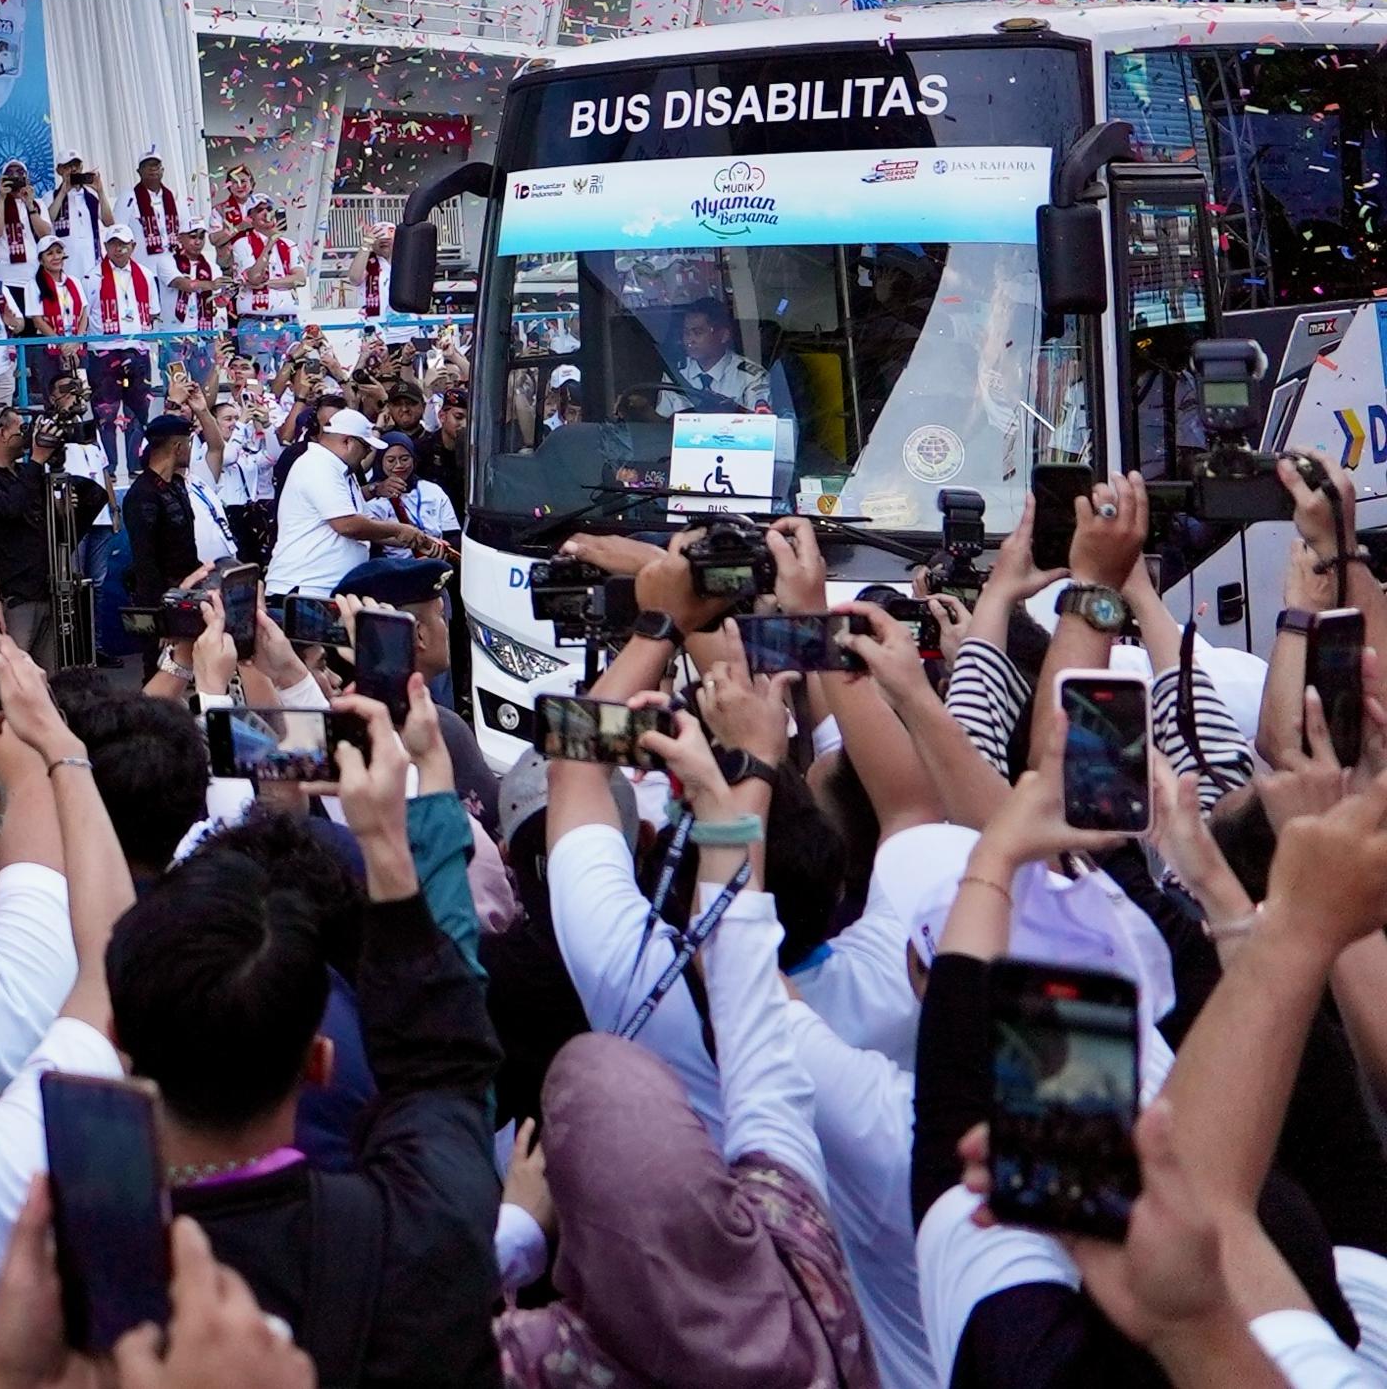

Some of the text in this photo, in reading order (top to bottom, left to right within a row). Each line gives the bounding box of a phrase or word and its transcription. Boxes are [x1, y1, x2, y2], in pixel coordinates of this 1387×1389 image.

[570, 74, 949, 138] BUS DISABILITAS
[951, 161, 1035, 172] JASA RAHARJA
[722, 184, 755, 193] MUDIK
[691, 195, 777, 218] Nyaman
[718, 211, 778, 226] Bersama
